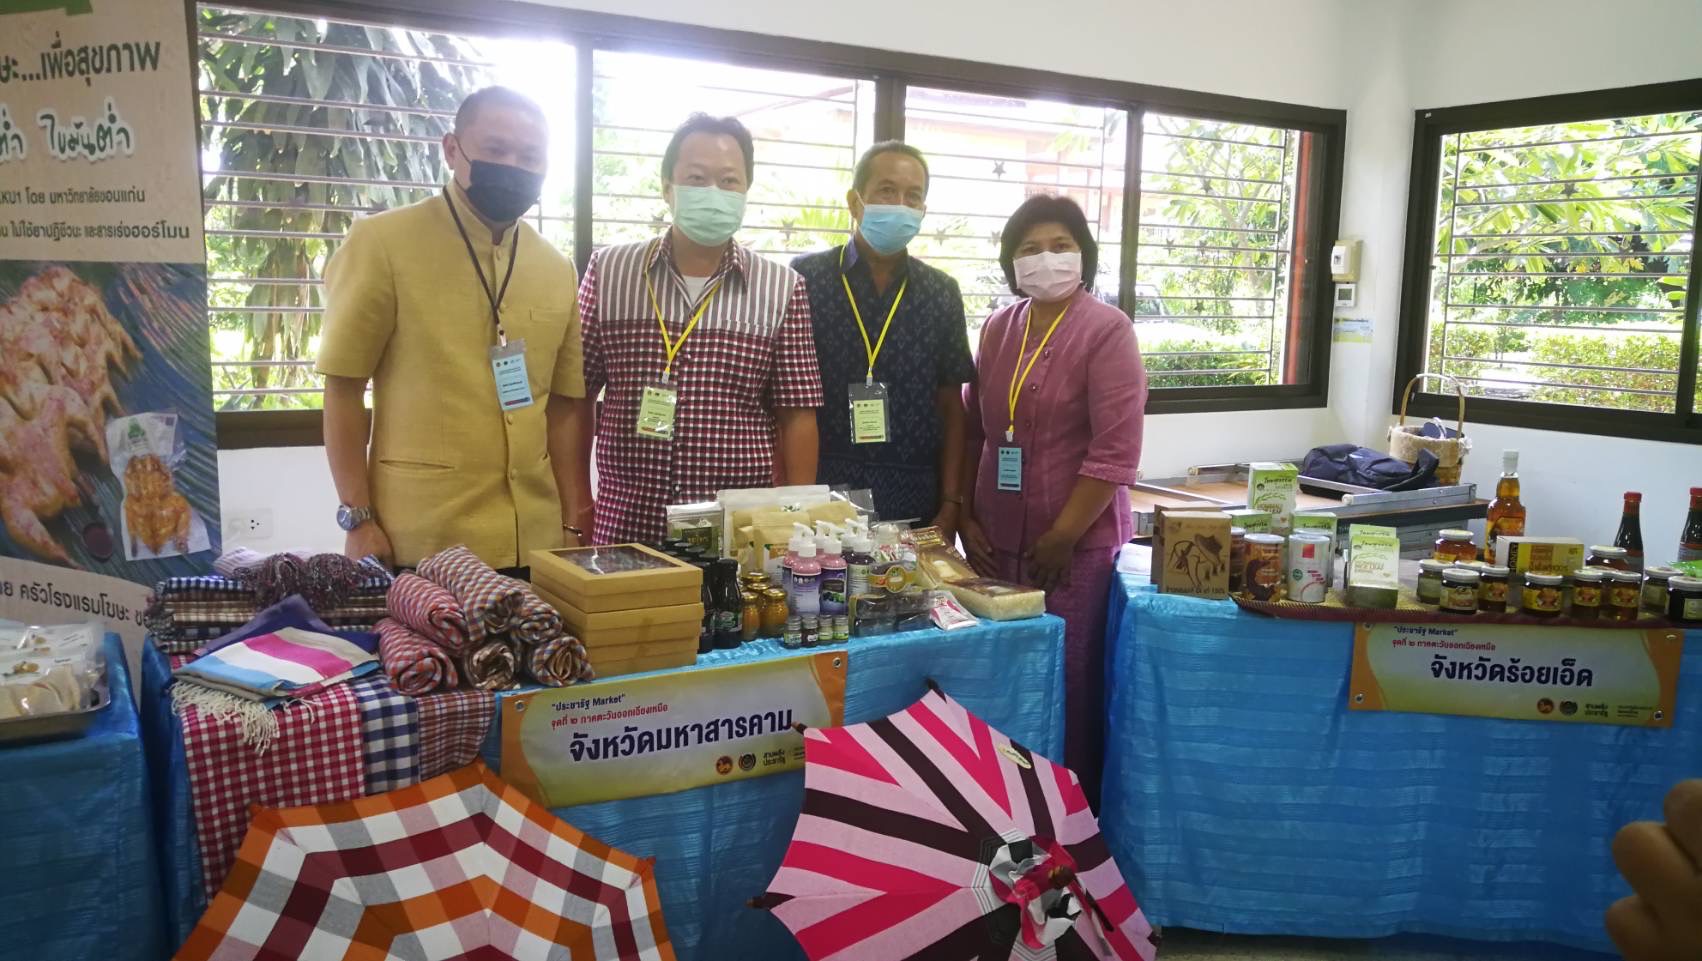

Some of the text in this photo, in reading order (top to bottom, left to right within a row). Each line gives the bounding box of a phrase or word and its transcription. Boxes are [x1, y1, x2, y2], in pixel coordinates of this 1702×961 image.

[39, 102, 131, 155] ไขมันต่ำ
[25, 187, 46, 205] โดย
[50, 186, 146, 205] มหาวิทยาลัยขอนแก่น
[1430, 653, 1594, 688] จังหวัดร้อยเอ็ด
[569, 708, 793, 763] จังหวัดมหาสารคาม
